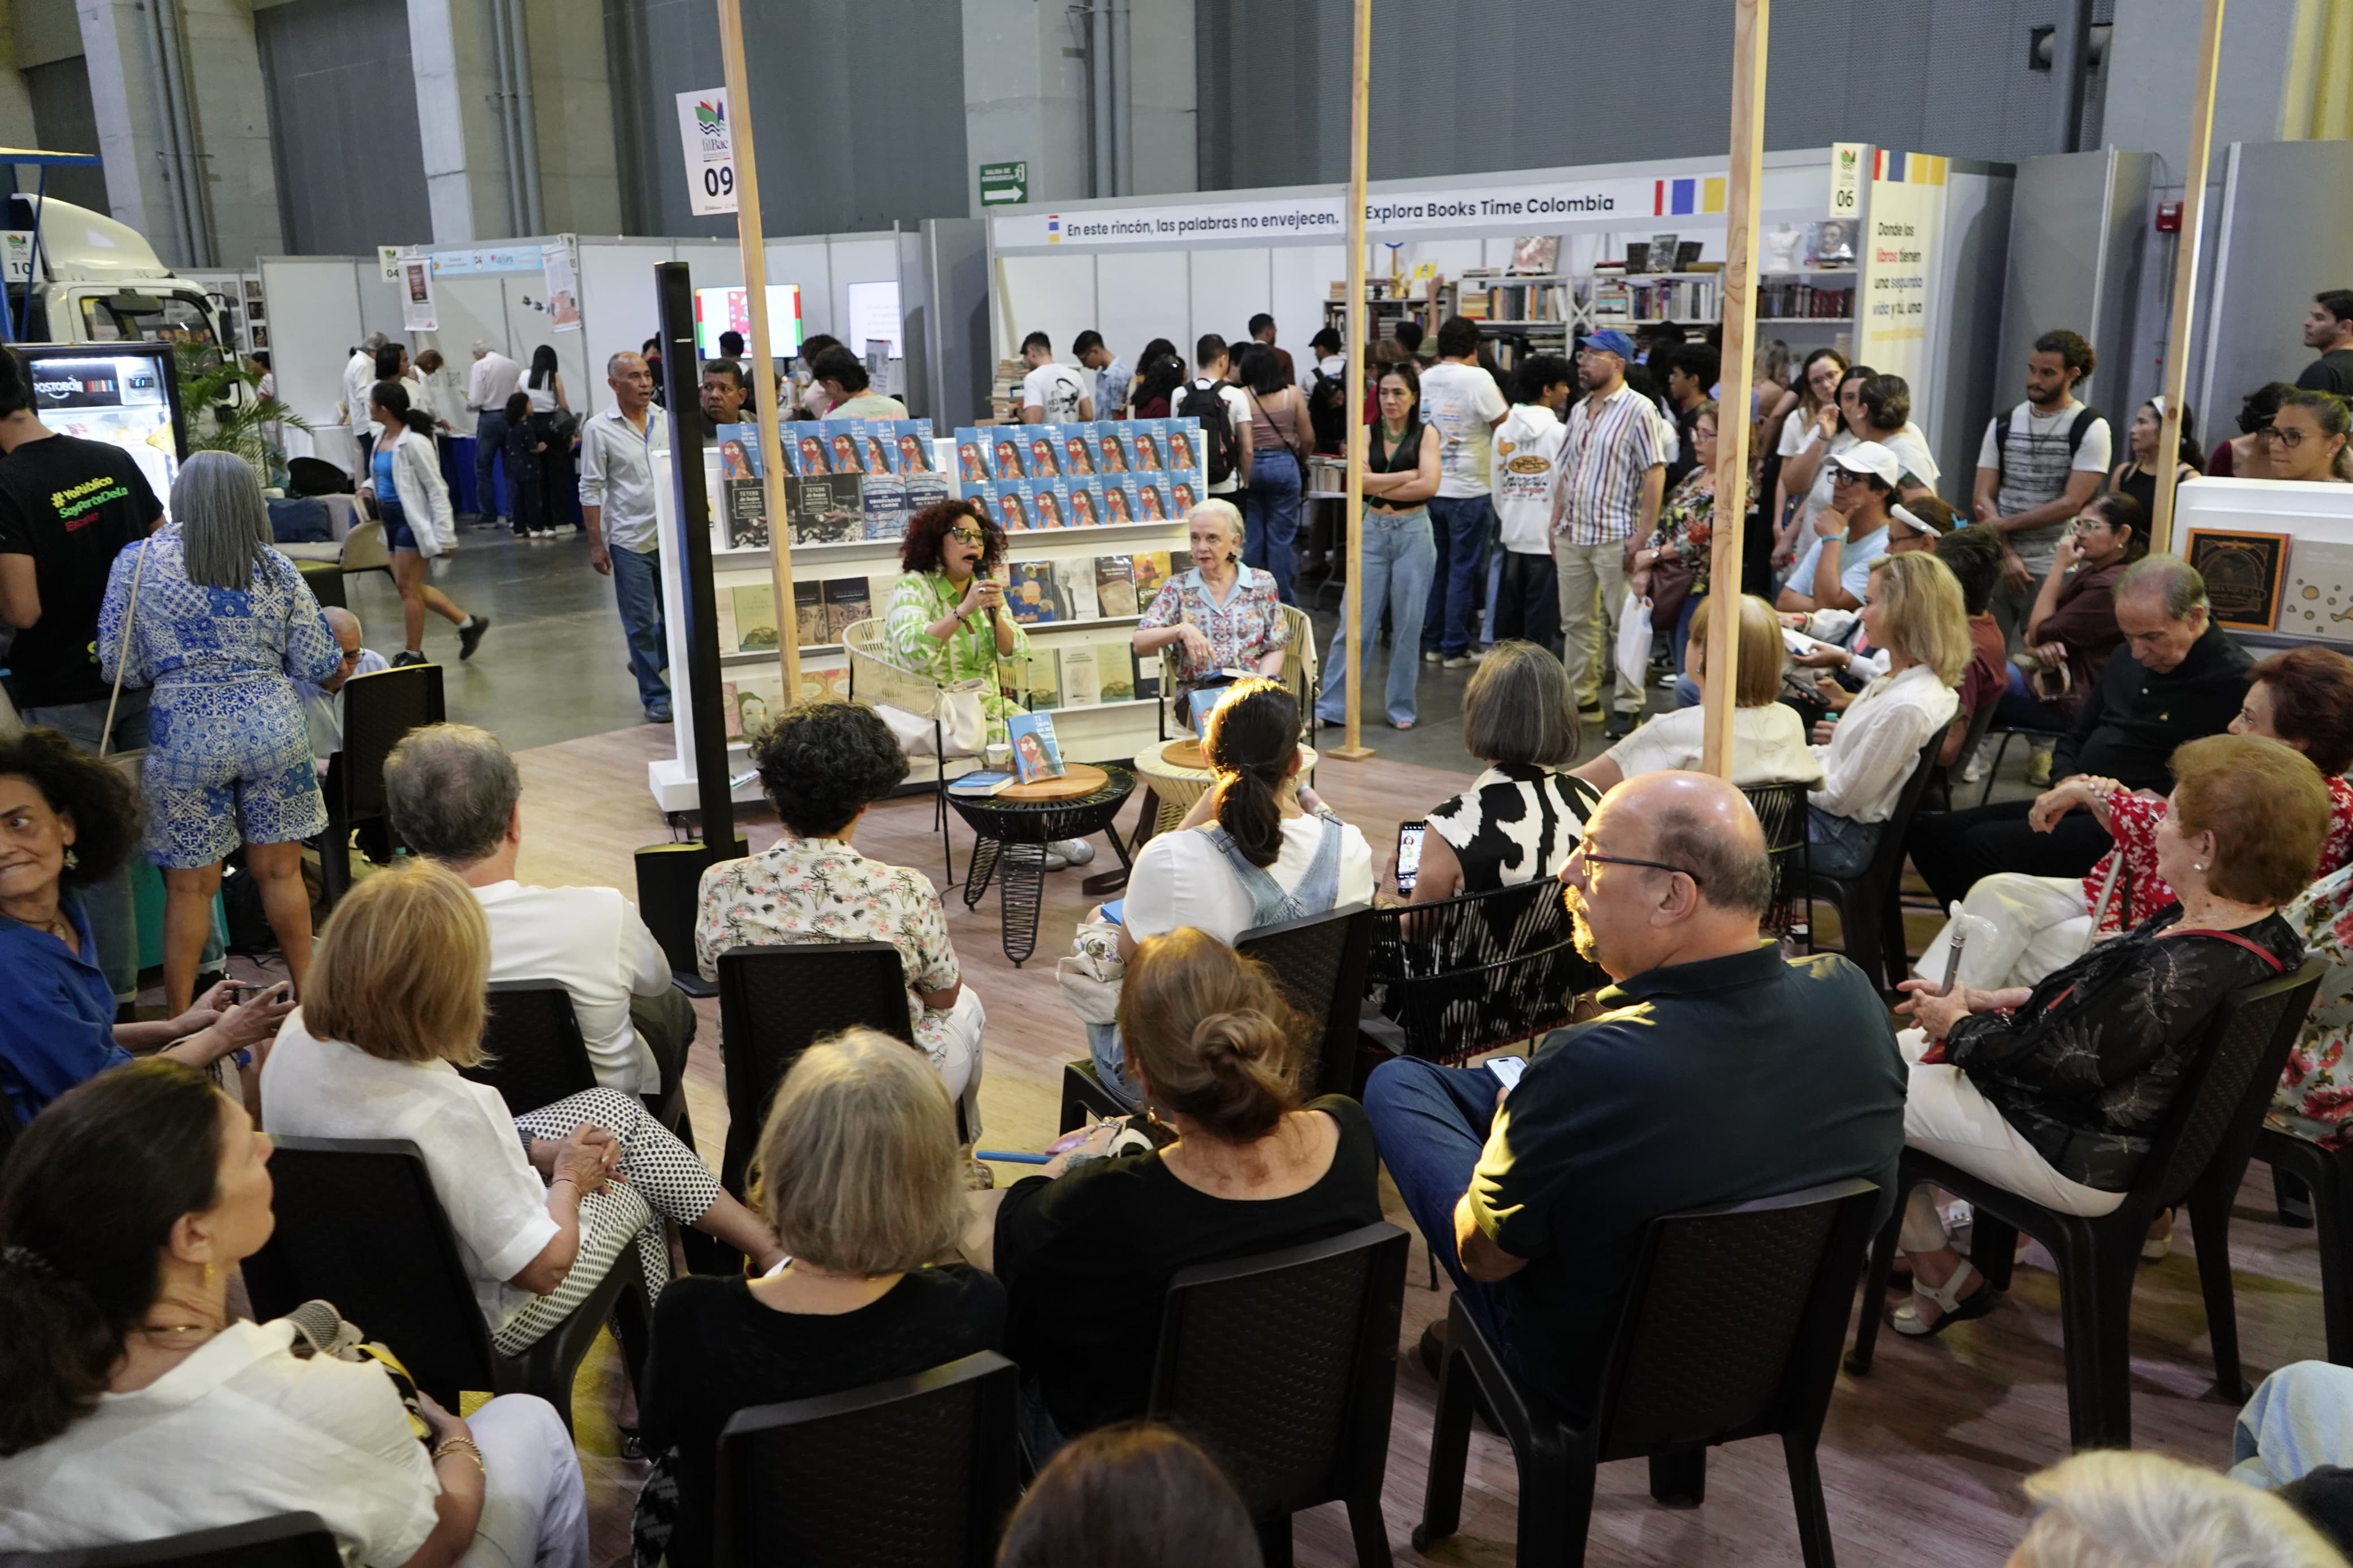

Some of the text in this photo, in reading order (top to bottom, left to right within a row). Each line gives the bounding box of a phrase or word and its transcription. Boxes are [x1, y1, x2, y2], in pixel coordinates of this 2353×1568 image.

[705, 166, 734, 197] 09
[1837, 190, 1854, 206] 06
[1068, 194, 1614, 236] En este rincón, las palabras no envejecen. Explora Books Time Colombia
[1878, 222, 1915, 236] Donde los
[1876, 247, 1921, 263] libros tienen
[1874, 278, 1889, 289] una
